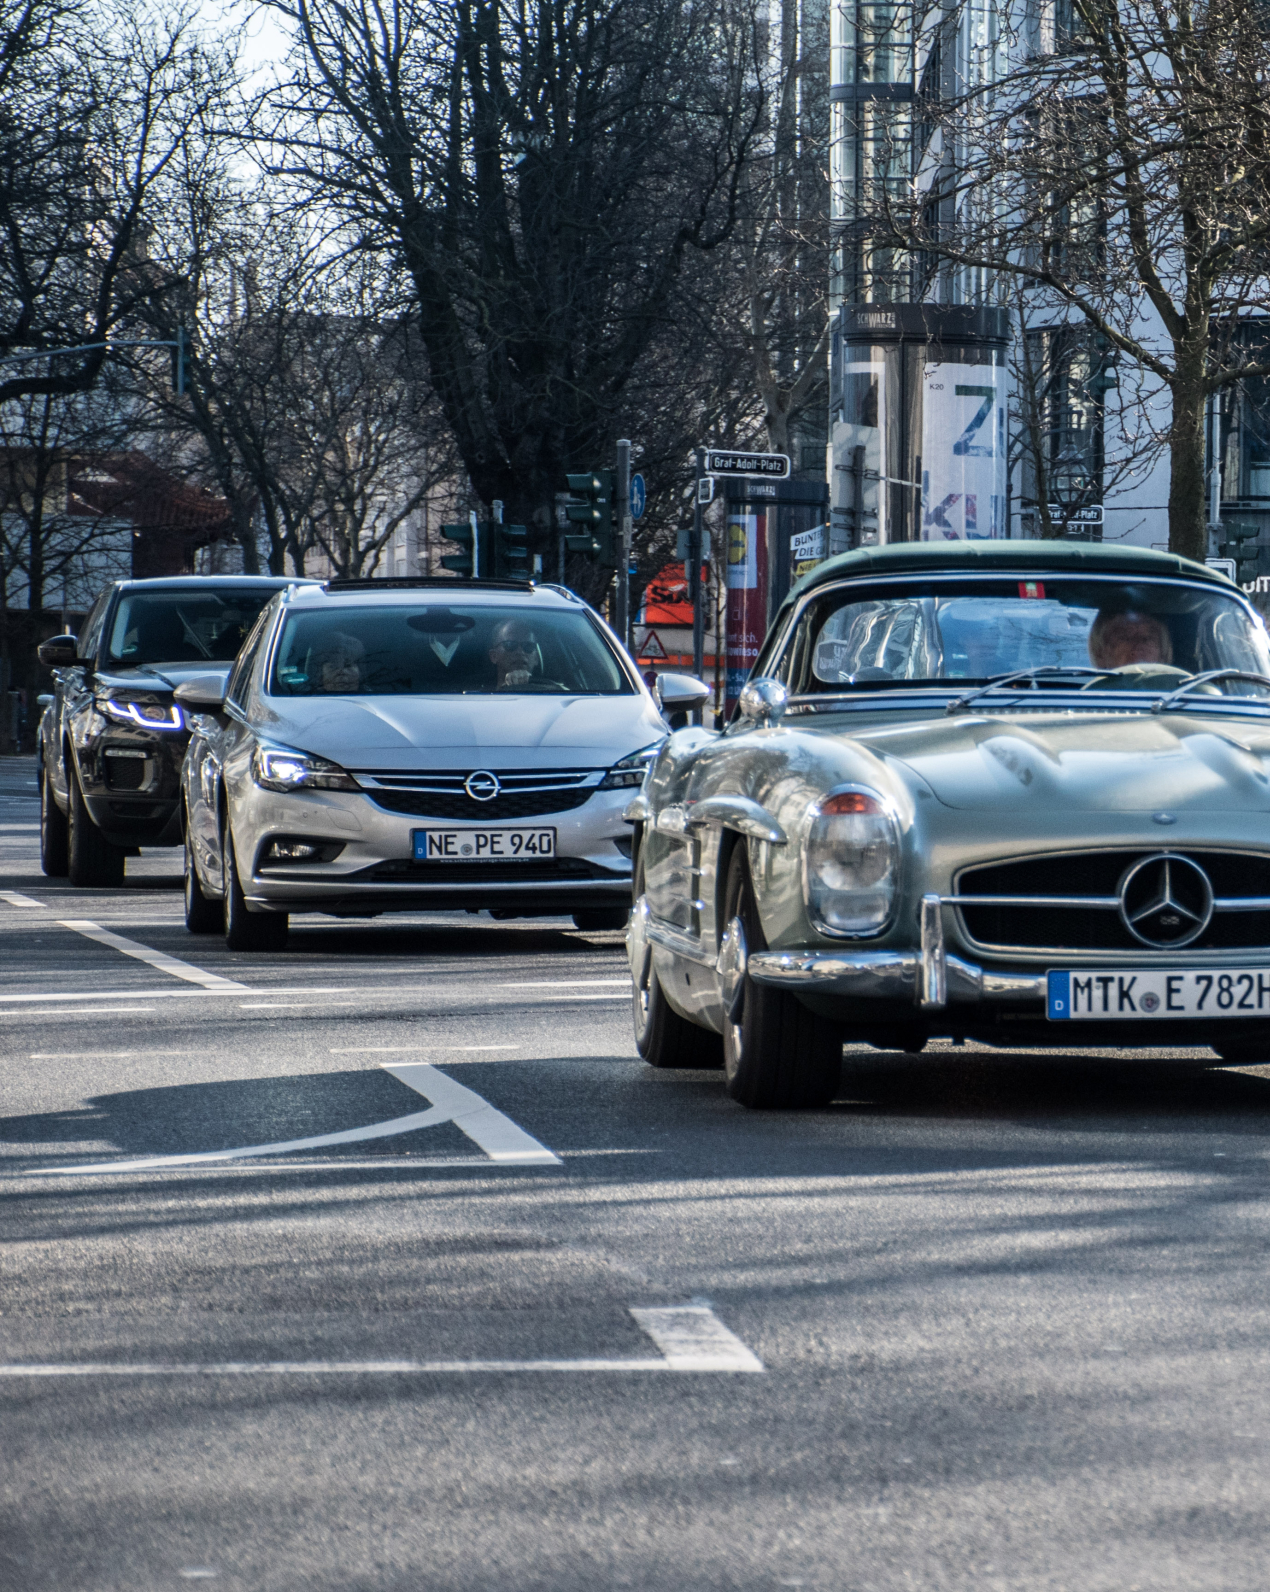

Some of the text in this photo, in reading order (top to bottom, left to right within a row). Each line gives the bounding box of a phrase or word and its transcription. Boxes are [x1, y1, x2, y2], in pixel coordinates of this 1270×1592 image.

[857, 312, 892, 328] SCHWARZ
[929, 383, 944, 391] K20
[714, 456, 782, 471] Graf-Adolf-Platz
[428, 833, 552, 856] NE PE 940
[1073, 976, 1138, 1012] MTK
[1166, 976, 1185, 1011] E
[1054, 1000, 1064, 1011] D
